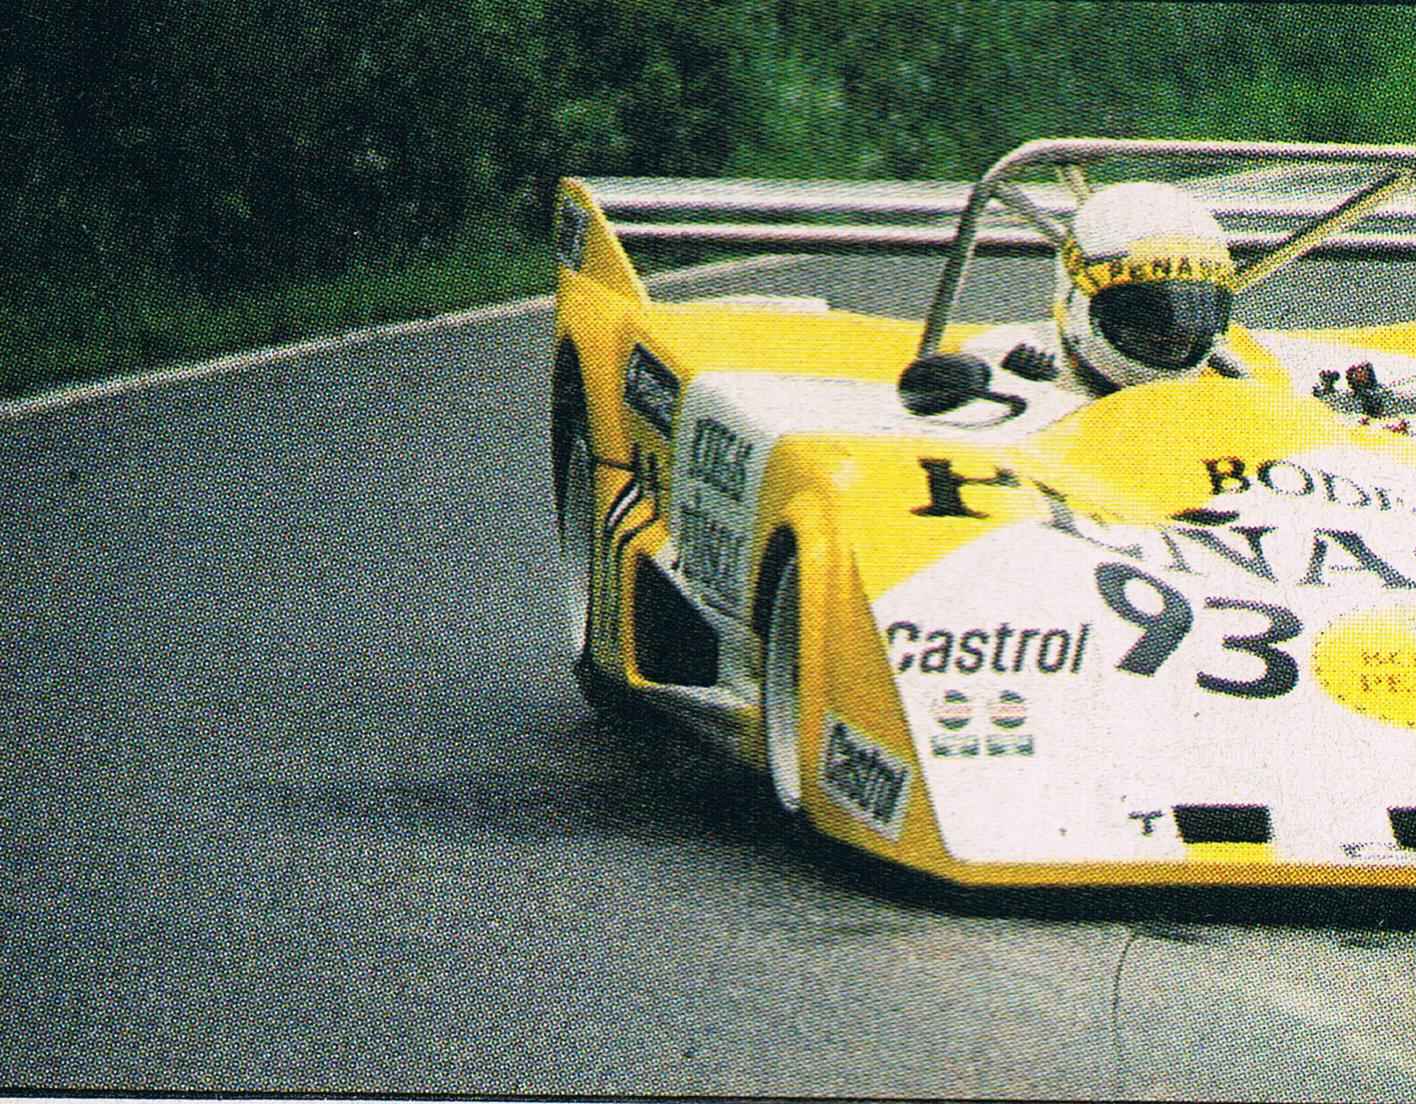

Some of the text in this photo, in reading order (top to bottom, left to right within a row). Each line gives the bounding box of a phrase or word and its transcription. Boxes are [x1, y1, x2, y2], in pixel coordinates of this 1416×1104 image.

[885, 620, 1091, 674] Castrol
[1094, 562, 1302, 699] 93
[1128, 810, 1163, 836] T
